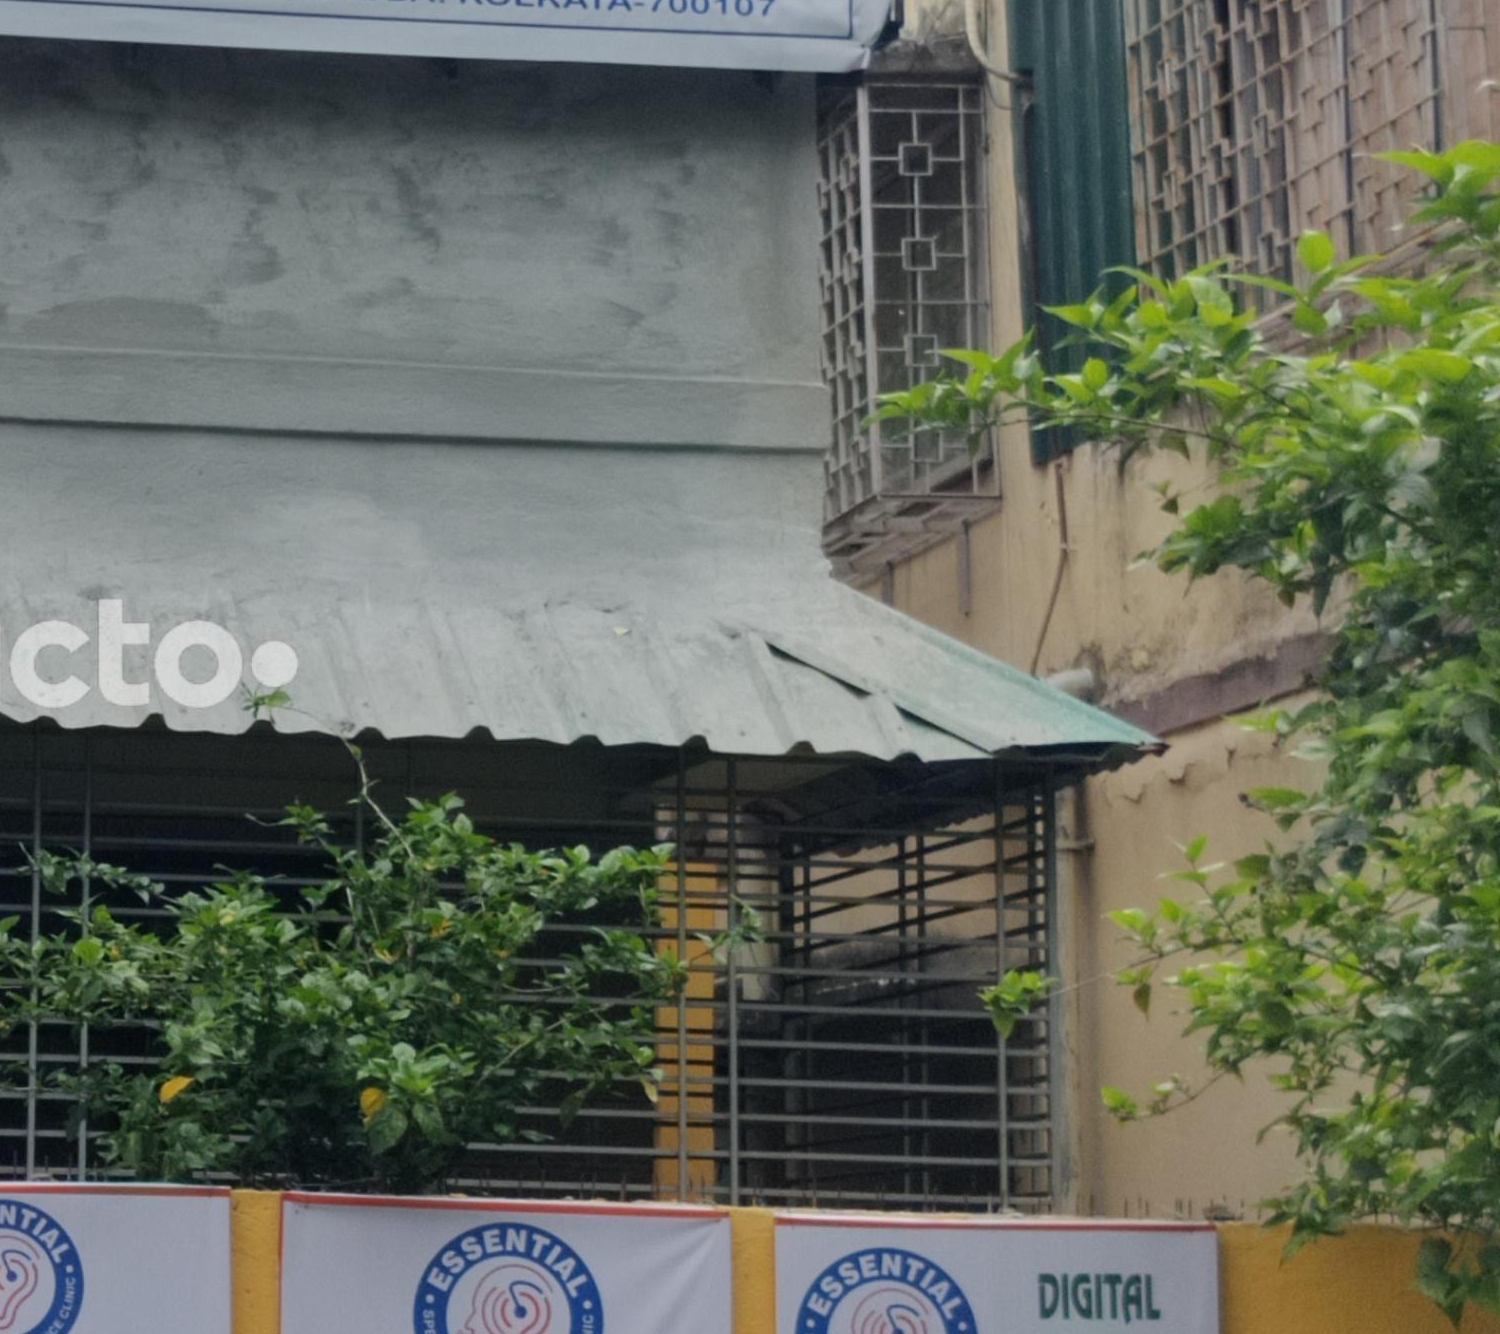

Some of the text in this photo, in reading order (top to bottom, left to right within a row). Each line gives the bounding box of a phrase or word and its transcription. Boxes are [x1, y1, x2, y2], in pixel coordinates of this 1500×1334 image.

[427, 1228, 588, 1298] ESSENTIAL
[807, 1253, 962, 1320] ESSENTIAL
[59, 1275, 76, 1320] CLINIC
[1038, 1273, 1161, 1324] DIGITAL
